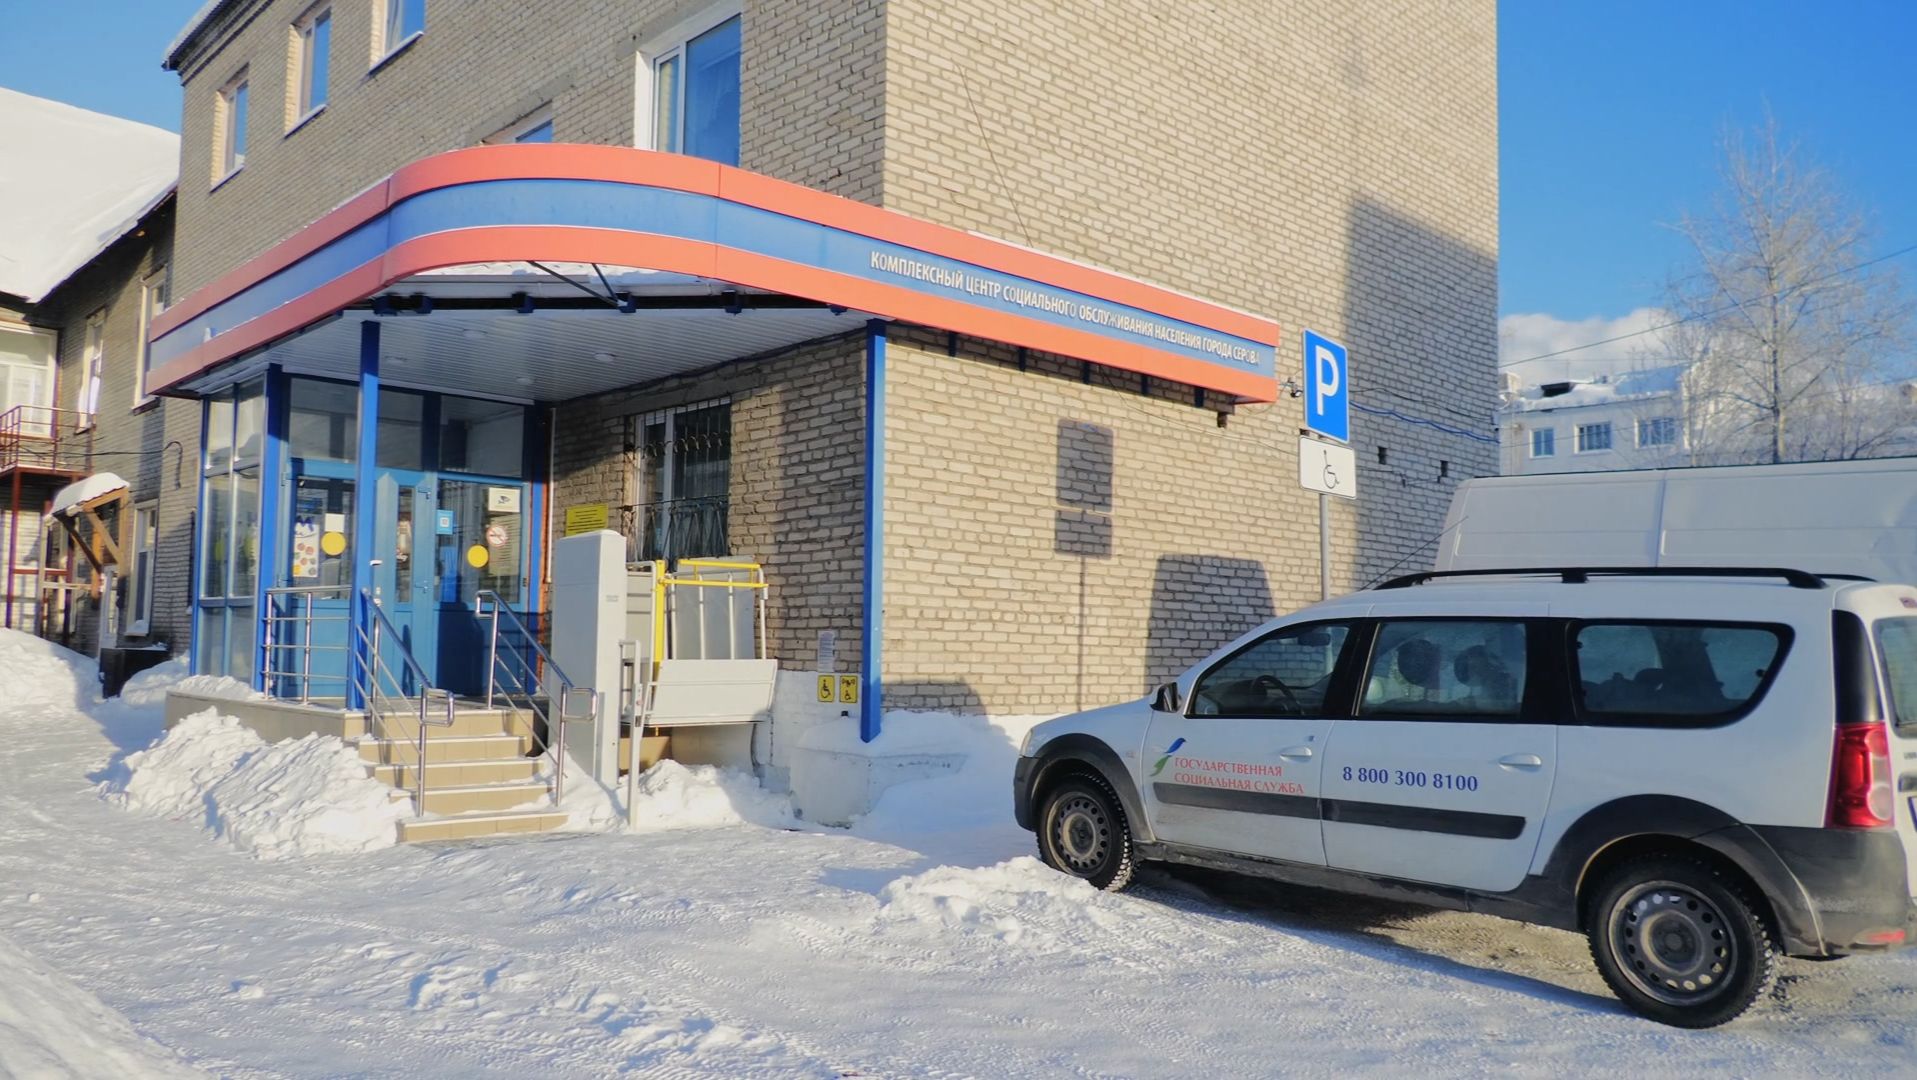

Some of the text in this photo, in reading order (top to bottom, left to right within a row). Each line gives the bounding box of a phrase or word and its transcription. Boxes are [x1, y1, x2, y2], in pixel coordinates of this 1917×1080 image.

[870, 251, 963, 289] КОМПЛЕКСНЫЙ
[965, 275, 1001, 298] ЦЕНТР
[1002, 285, 1077, 318] СОЦИАЛЬНОГО
[1079, 304, 1154, 337] ОБСЛУЖИВАНИЯ
[1155, 326, 1202, 349] НАСЕЛЕНИЯ
[1202, 338, 1232, 358] ГОРОДА
[1315, 345, 1340, 416] P
[1174, 757, 1282, 777] ГОСУДАРСТВЕННАЯ
[1342, 766, 1478, 792] 8 800 300 8100
[1174, 772, 1304, 794] СОЦИАЛЬНАЯ СЛУЖБА
